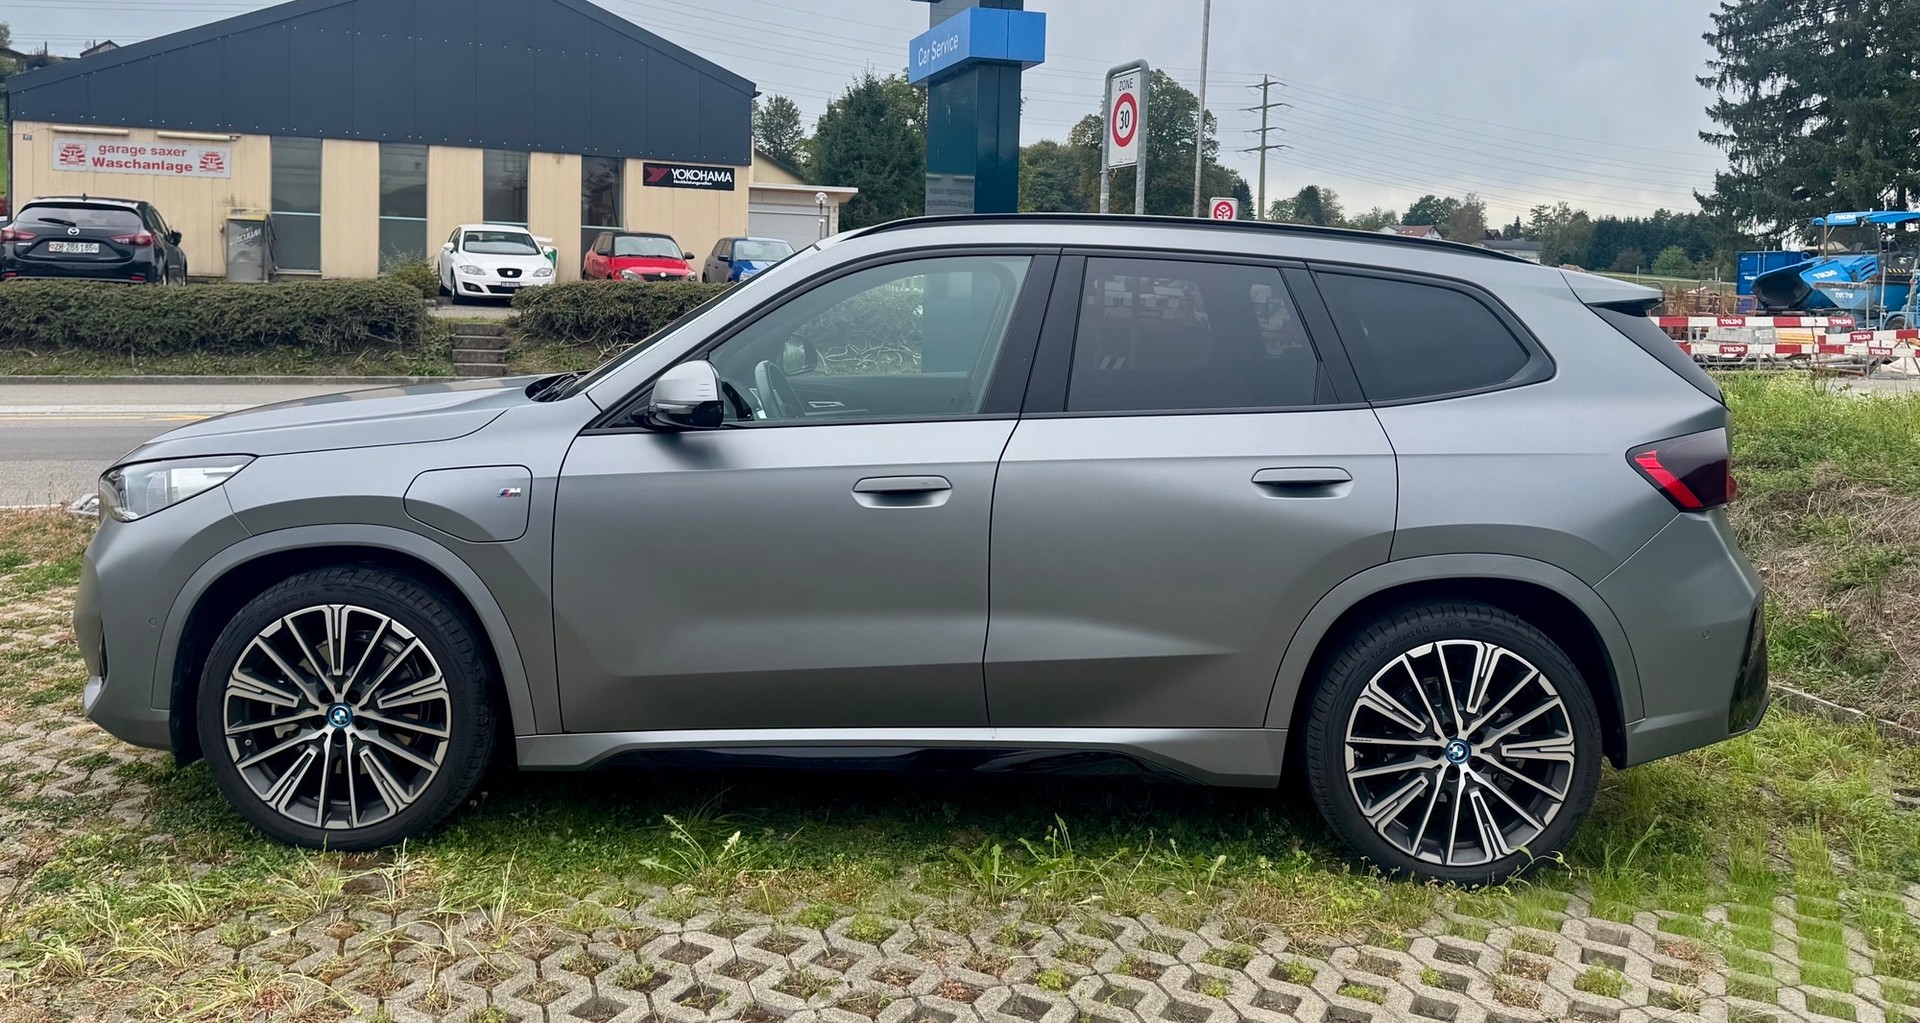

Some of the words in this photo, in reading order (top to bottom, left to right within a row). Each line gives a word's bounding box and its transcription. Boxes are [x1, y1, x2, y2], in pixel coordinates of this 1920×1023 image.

[917, 46, 930, 67] Car
[931, 33, 959, 60] Service
[1118, 77, 1133, 92] ZONE
[1119, 109, 1130, 130] 30
[98, 143, 147, 156] garage
[150, 146, 187, 157] saxer
[91, 156, 193, 174] Waschanlage
[670, 167, 732, 183] YOKOHAMA
[1812, 269, 1837, 280] TOLDO
[1720, 318, 1743, 326] TOLDO
[1830, 318, 1852, 326] TOLDO
[1852, 333, 1871, 341] TOLDO
[1722, 345, 1745, 353] TOLDO
[1870, 348, 1891, 356] TOLDO
[1369, 630, 1415, 659] EcoContact
